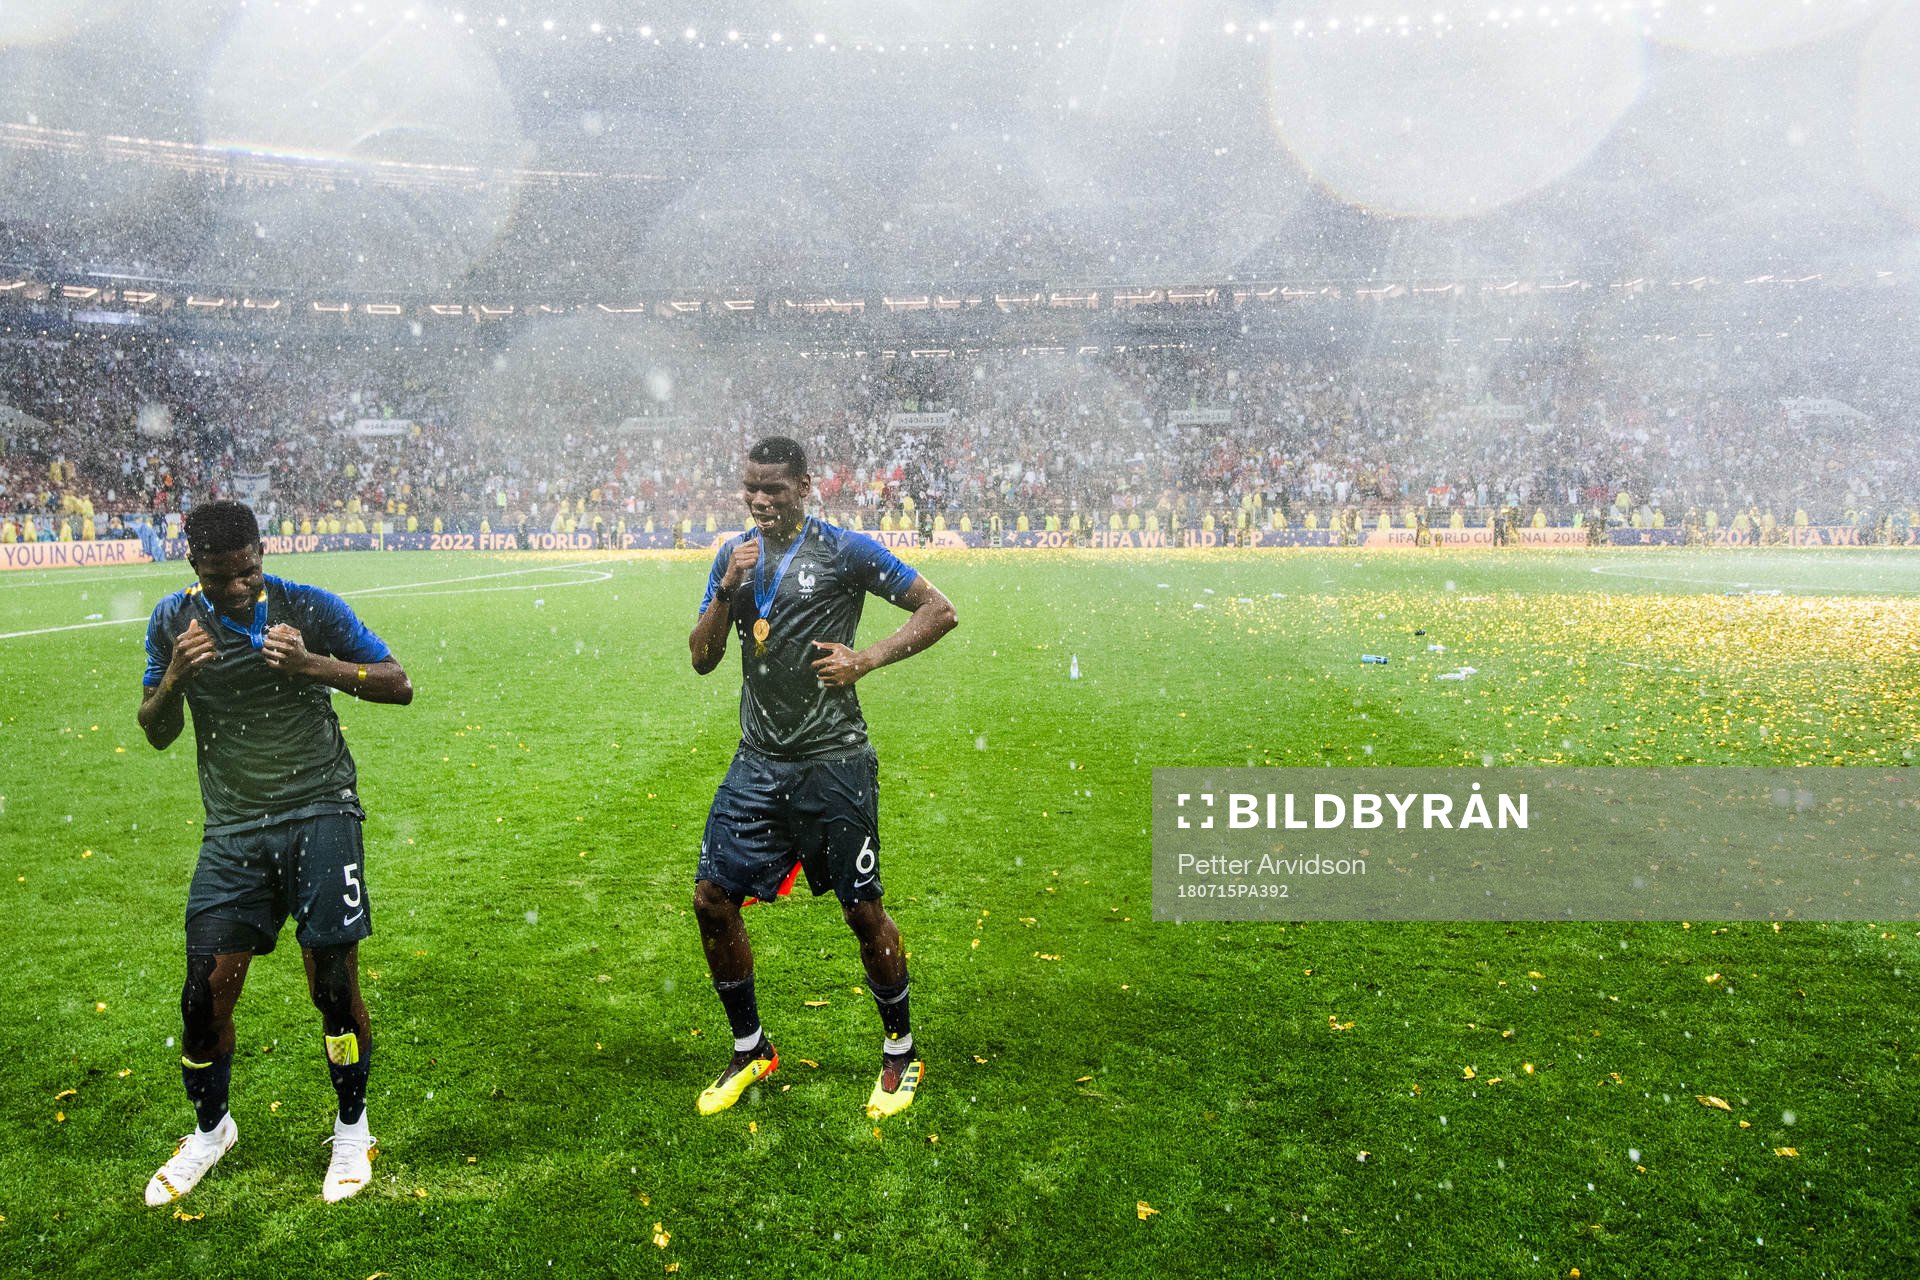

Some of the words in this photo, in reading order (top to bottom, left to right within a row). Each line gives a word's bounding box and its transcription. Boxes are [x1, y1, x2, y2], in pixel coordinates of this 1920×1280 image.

[260, 536, 293, 554] ORLD
[295, 535, 319, 552] CUP
[430, 534, 474, 550] 2022
[480, 534, 518, 549] FIFA
[866, 532, 919, 546] ATAR
[1035, 531, 1074, 548] 202
[1092, 531, 1133, 547] FIFA
[1474, 532, 1493, 543] CU
[4, 546, 44, 566] YOU
[50, 545, 67, 564] IN
[72, 543, 125, 565] QATAR
[856, 836, 875, 874] 6
[343, 863, 360, 907] 5
